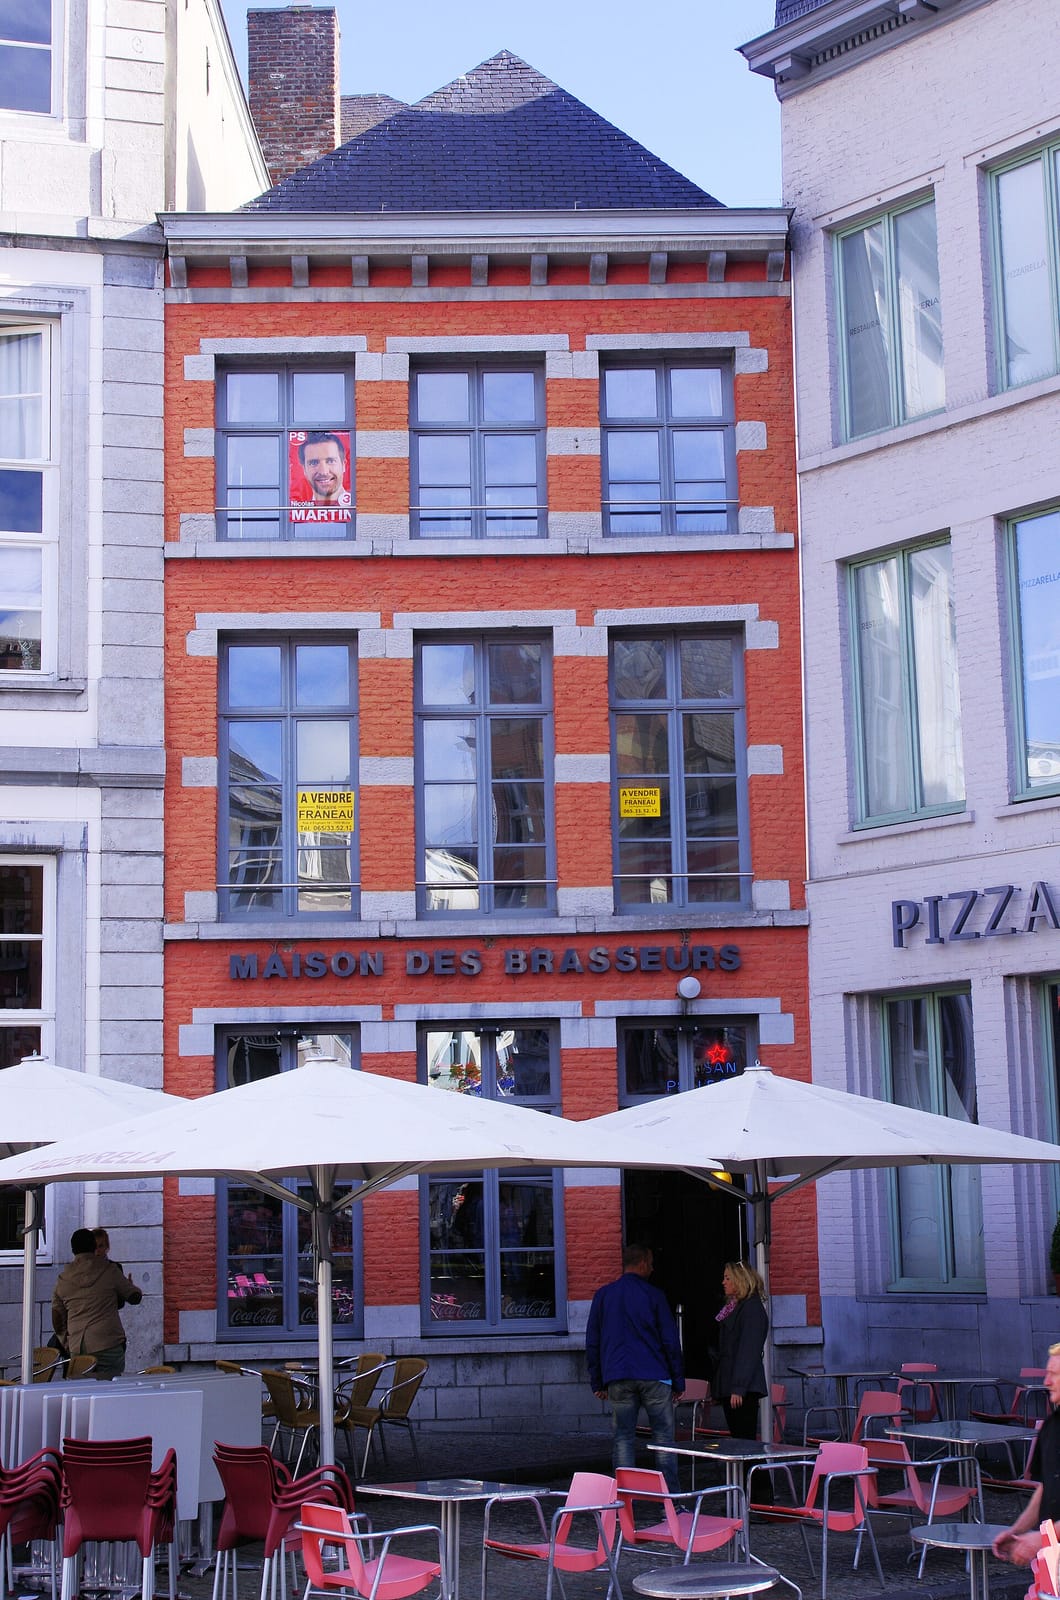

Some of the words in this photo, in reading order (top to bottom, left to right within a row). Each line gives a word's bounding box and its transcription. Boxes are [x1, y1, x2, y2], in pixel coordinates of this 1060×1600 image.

[289, 432, 306, 441] PS
[342, 494, 350, 503] 3
[300, 793, 308, 803] A
[310, 793, 352, 803] VENDRE
[298, 810, 353, 818] FRANEAU
[229, 951, 385, 980] MAISON
[406, 949, 483, 977] DES
[504, 944, 742, 975] BRASSEURS
[704, 1062, 736, 1074] SAN
